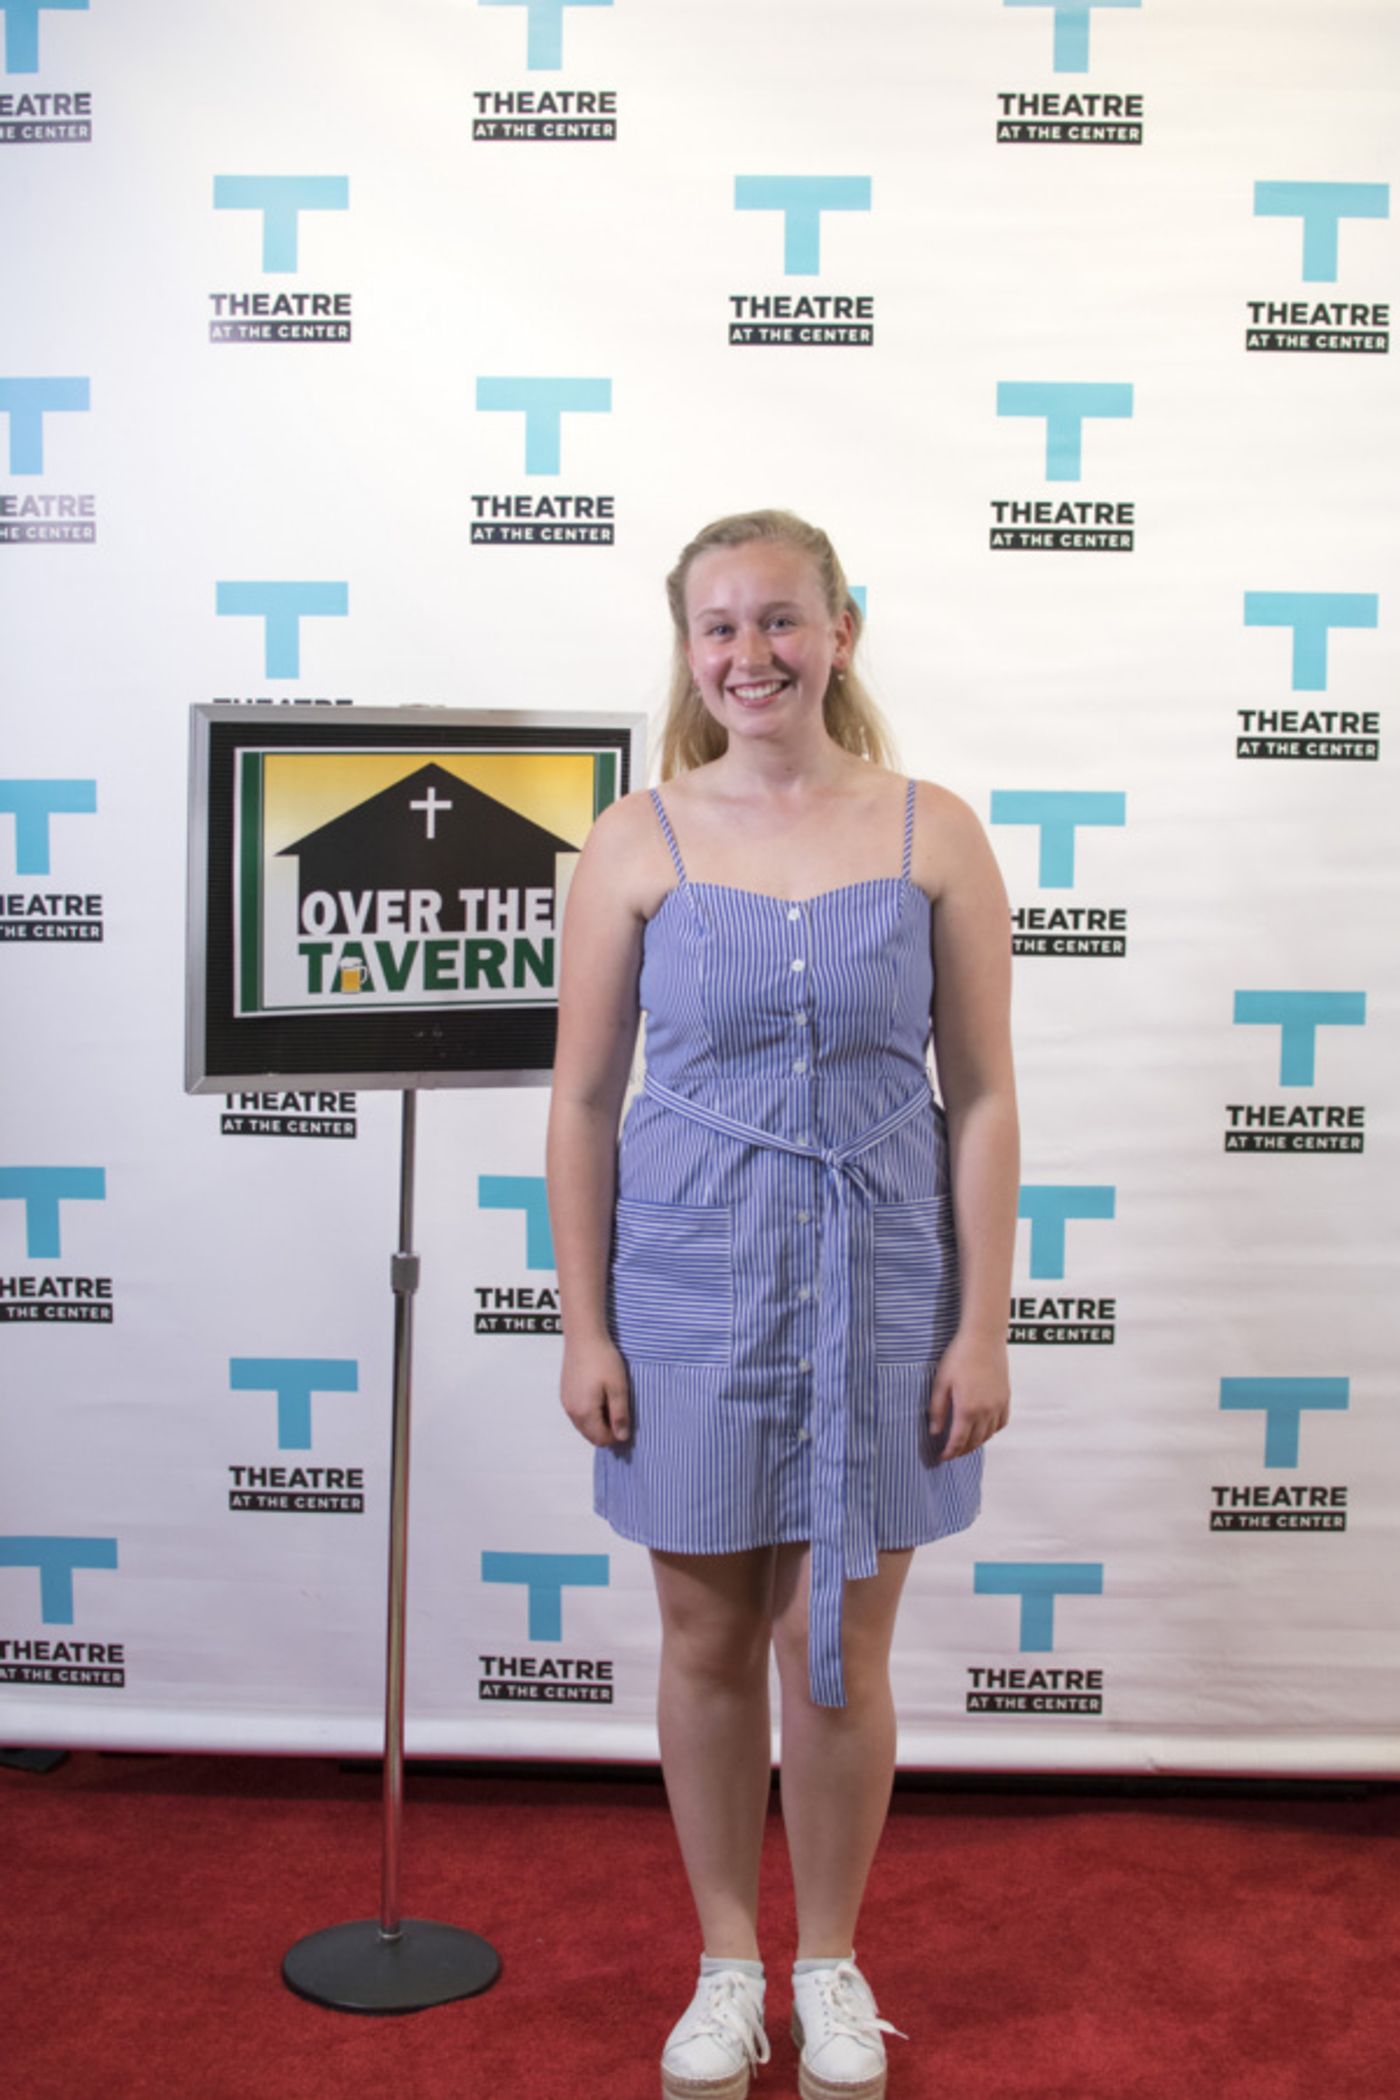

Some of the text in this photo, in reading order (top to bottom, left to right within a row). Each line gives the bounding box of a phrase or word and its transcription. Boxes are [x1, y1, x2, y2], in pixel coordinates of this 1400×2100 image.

[0, 93, 91, 116] EATRE
[474, 92, 616, 113] THEATRE
[998, 94, 1142, 117] THEATRE
[22, 124, 88, 139] CENTER
[475, 123, 612, 137] AT THE CENTER
[999, 125, 1139, 141] AT THE CENTER
[209, 293, 352, 316] THEATRE
[730, 296, 873, 318] THEATRE
[1248, 302, 1389, 326] THEATRE
[212, 325, 348, 340] AT THE CENTER
[732, 328, 869, 342] AT THE CENTER
[1249, 334, 1385, 350] AT THE CENTER
[0, 494, 95, 518] EATRE
[472, 496, 614, 518] THEATRE
[991, 502, 1134, 524] THEATRE
[0, 526, 93, 540] HE CENTER
[473, 527, 610, 541] AT THE CENTER
[992, 532, 1130, 548] AT THE CENTER
[1238, 710, 1379, 733] THEATRE
[1239, 741, 1375, 757] AT THE CENTER
[0, 895, 101, 915] EATRE
[301, 887, 554, 936] OVER THE
[1011, 909, 1126, 930] HEATRE
[33, 925, 100, 938] CENTER
[1013, 939, 1122, 953] THE CENTER
[298, 938, 554, 993] TAVERN
[1226, 1106, 1364, 1127] THEATRE
[223, 1118, 354, 1135] AT THE CENTER
[1227, 1135, 1361, 1149] AT THE CENTER
[0, 1277, 112, 1298] HEATRE
[475, 1288, 559, 1309] THEA
[8, 1306, 110, 1320] THE CENTER
[1010, 1298, 1115, 1319] EATRE
[477, 1318, 497, 1330] AT
[504, 1318, 534, 1330] THE
[1044, 1327, 1112, 1341] CENTER
[229, 1466, 363, 1488] THEATRE
[231, 1495, 360, 1510] AT THE CENTER
[1212, 1487, 1347, 1506] THEATRE
[1213, 1515, 1344, 1528] AT THE CENTER
[23, 1669, 51, 1682] THE
[59, 1671, 122, 1684] CENTER
[480, 1657, 612, 1682] THEATRE
[968, 1668, 1102, 1689] THEATRE
[481, 1684, 610, 1701] AT THE CENTER
[969, 1696, 1100, 1710] AT THE CENTER
